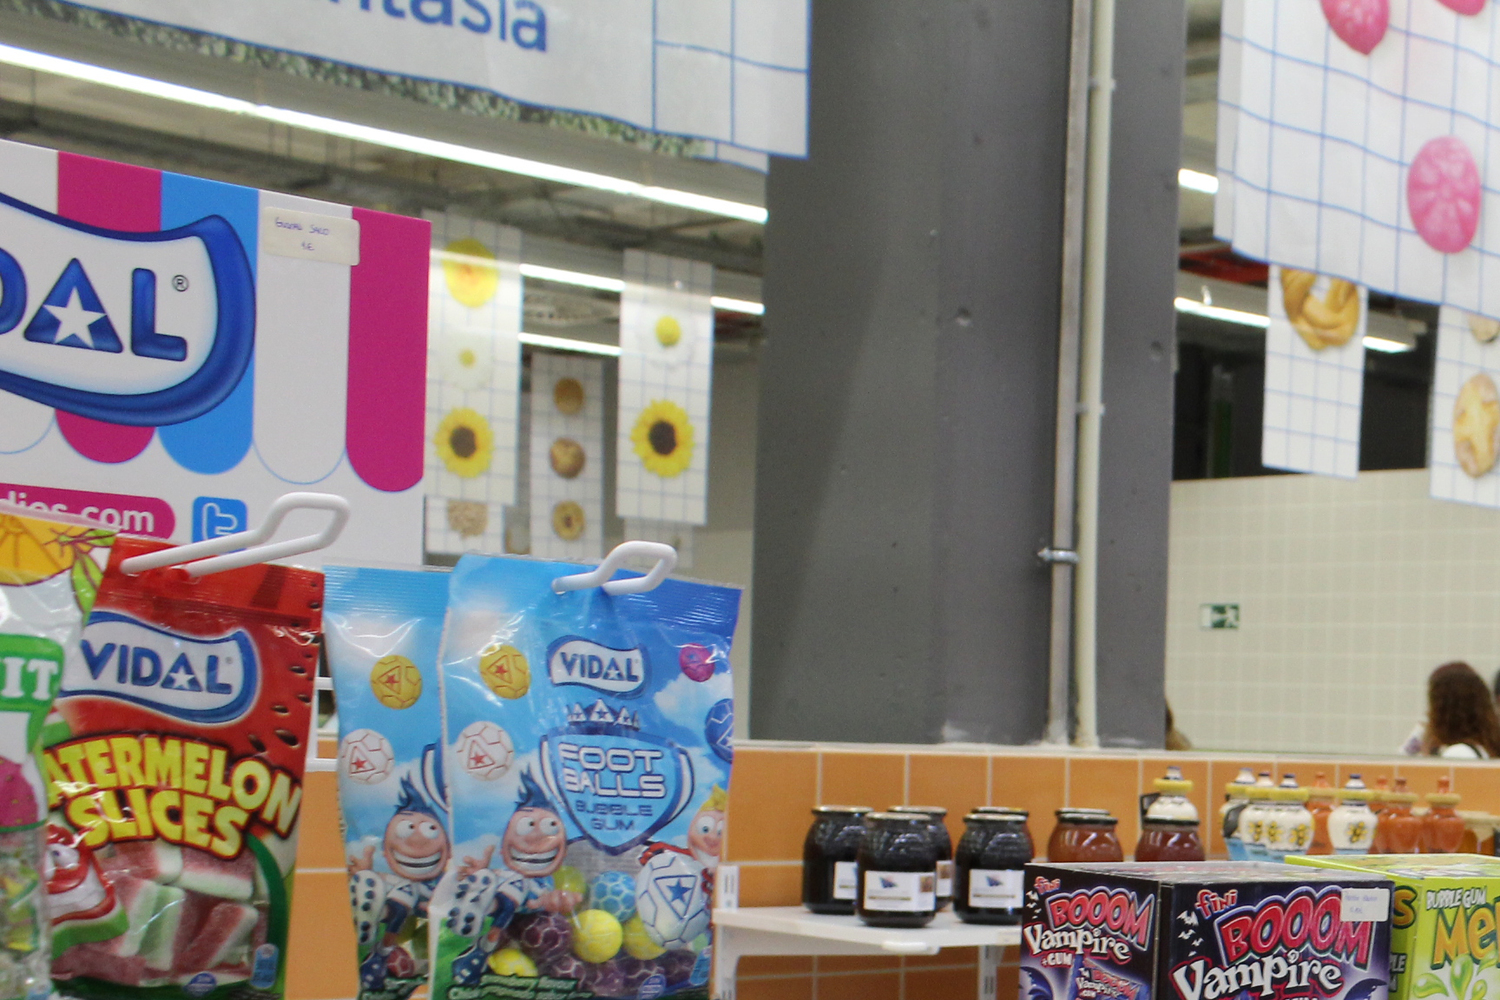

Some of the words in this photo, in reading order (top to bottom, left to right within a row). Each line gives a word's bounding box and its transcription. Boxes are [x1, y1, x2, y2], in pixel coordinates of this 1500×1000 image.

[80, 638, 234, 696] VIDAL
[559, 650, 641, 684] VIDAL
[557, 741, 664, 774] FOOT
[562, 765, 668, 799] BALLS
[66, 788, 250, 860] SLICES
[575, 800, 655, 818] BUBBLE
[590, 817, 635, 832] GUM
[1047, 887, 1155, 950] BOOOM
[1214, 886, 1378, 970] BOOOM
[1023, 923, 1132, 962] Vampire
